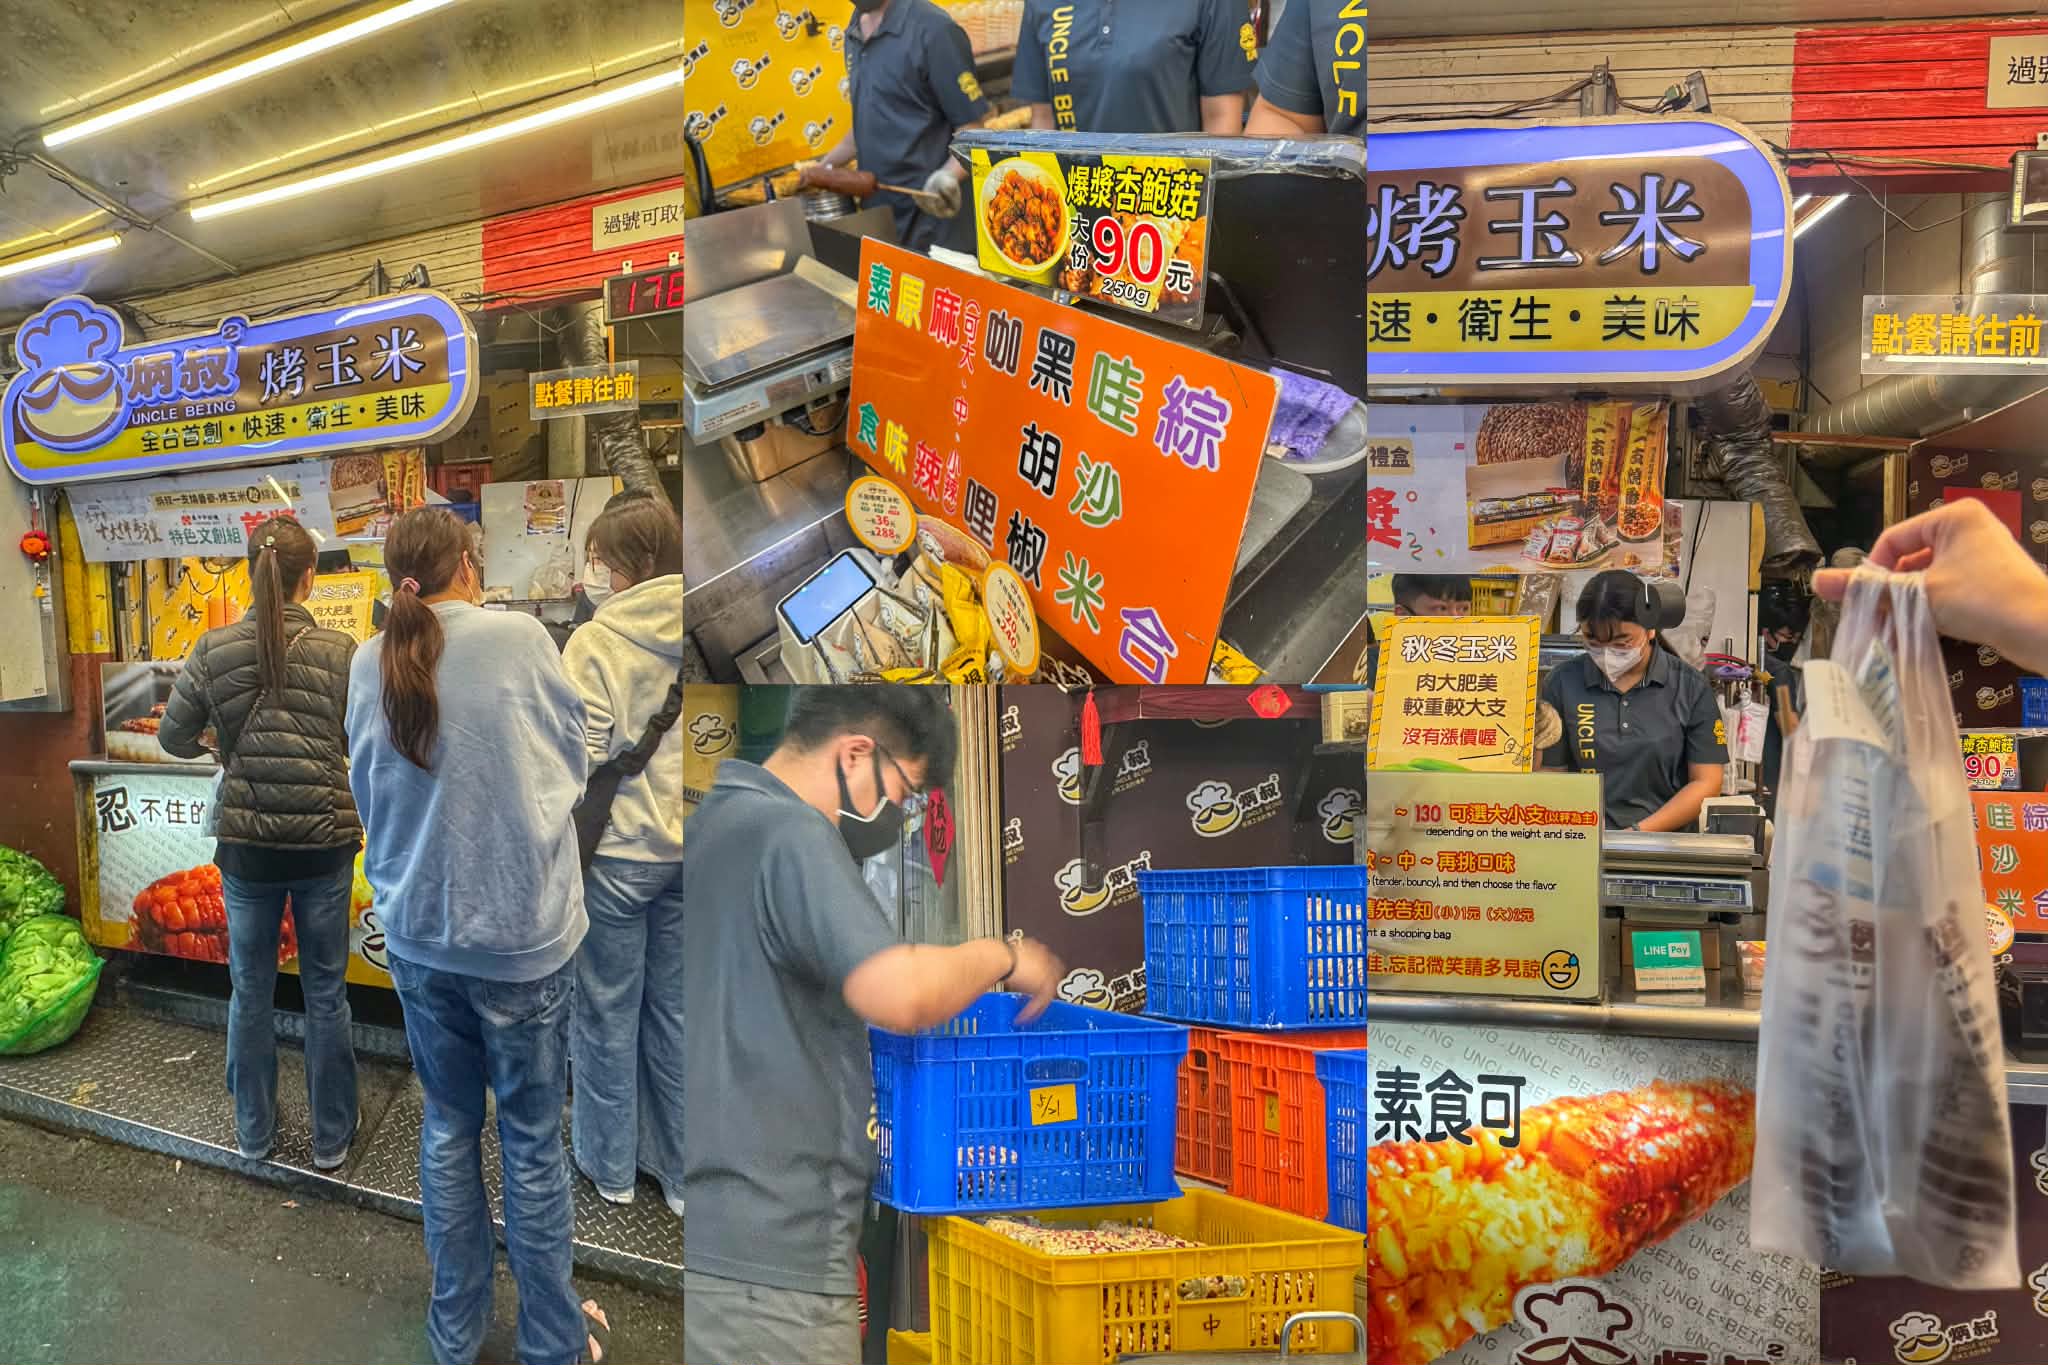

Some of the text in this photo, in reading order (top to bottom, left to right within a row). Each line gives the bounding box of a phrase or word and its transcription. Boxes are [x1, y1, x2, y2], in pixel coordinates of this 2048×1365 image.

[1049, 5, 1073, 83] UNCLE
[1367, 173, 1705, 281] 烤玉米
[1070, 213, 1091, 271] 大份
[1092, 215, 1164, 284] 90
[1167, 261, 1194, 295] 元
[1101, 278, 1151, 306] 250g
[1871, 313, 2043, 358] 點餐請往前
[128, 347, 234, 399] 炳叔
[259, 326, 426, 403] 烤玉米
[535, 373, 634, 409] 點餐請往前
[132, 399, 237, 425] UNCLE BEING
[1369, 446, 1411, 468] 禮盒
[168, 526, 241, 545] 特色文創組
[1402, 634, 1518, 664] 秋冬玉米
[1415, 673, 1498, 694] 肉大肥美
[1402, 697, 1508, 719] 較重較大支
[1402, 727, 1498, 748] 沒有漲價喔
[1576, 703, 1595, 760] UNCLE
[1965, 754, 2001, 779] 90
[1415, 804, 1442, 824] 130
[1426, 827, 1587, 840] depending on the weight and size.
[1437, 851, 1516, 873] 再挑口味
[1443, 879, 1460, 888] and
[1461, 879, 1482, 889] then
[1483, 880, 1514, 889] choose
[1516, 879, 1531, 889] the
[1389, 928, 1431, 941] shopping
[1433, 930, 1451, 941] bag
[1643, 945, 1689, 957] LINE Pay
[1373, 1065, 1527, 1149] 素食可
[1202, 1313, 1221, 1337] 中
